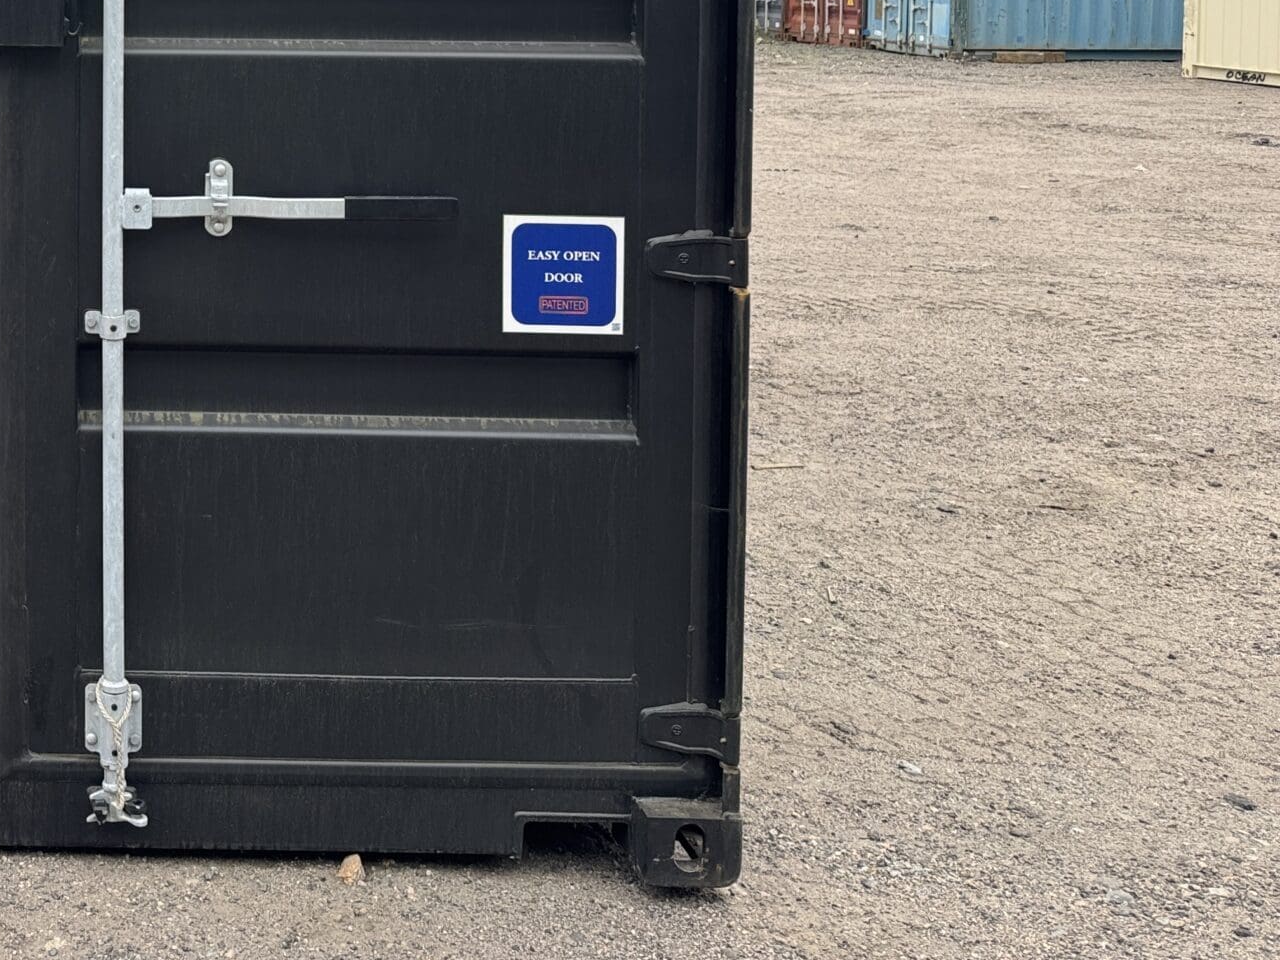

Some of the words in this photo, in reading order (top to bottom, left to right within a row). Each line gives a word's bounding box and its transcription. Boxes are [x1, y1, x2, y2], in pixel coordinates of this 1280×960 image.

[1226, 70, 1266, 83] OCEAN
[527, 249, 561, 260] EASY
[563, 250, 600, 261] OPEN
[544, 272, 583, 283] DOOR
[541, 300, 585, 311] PATENTED
